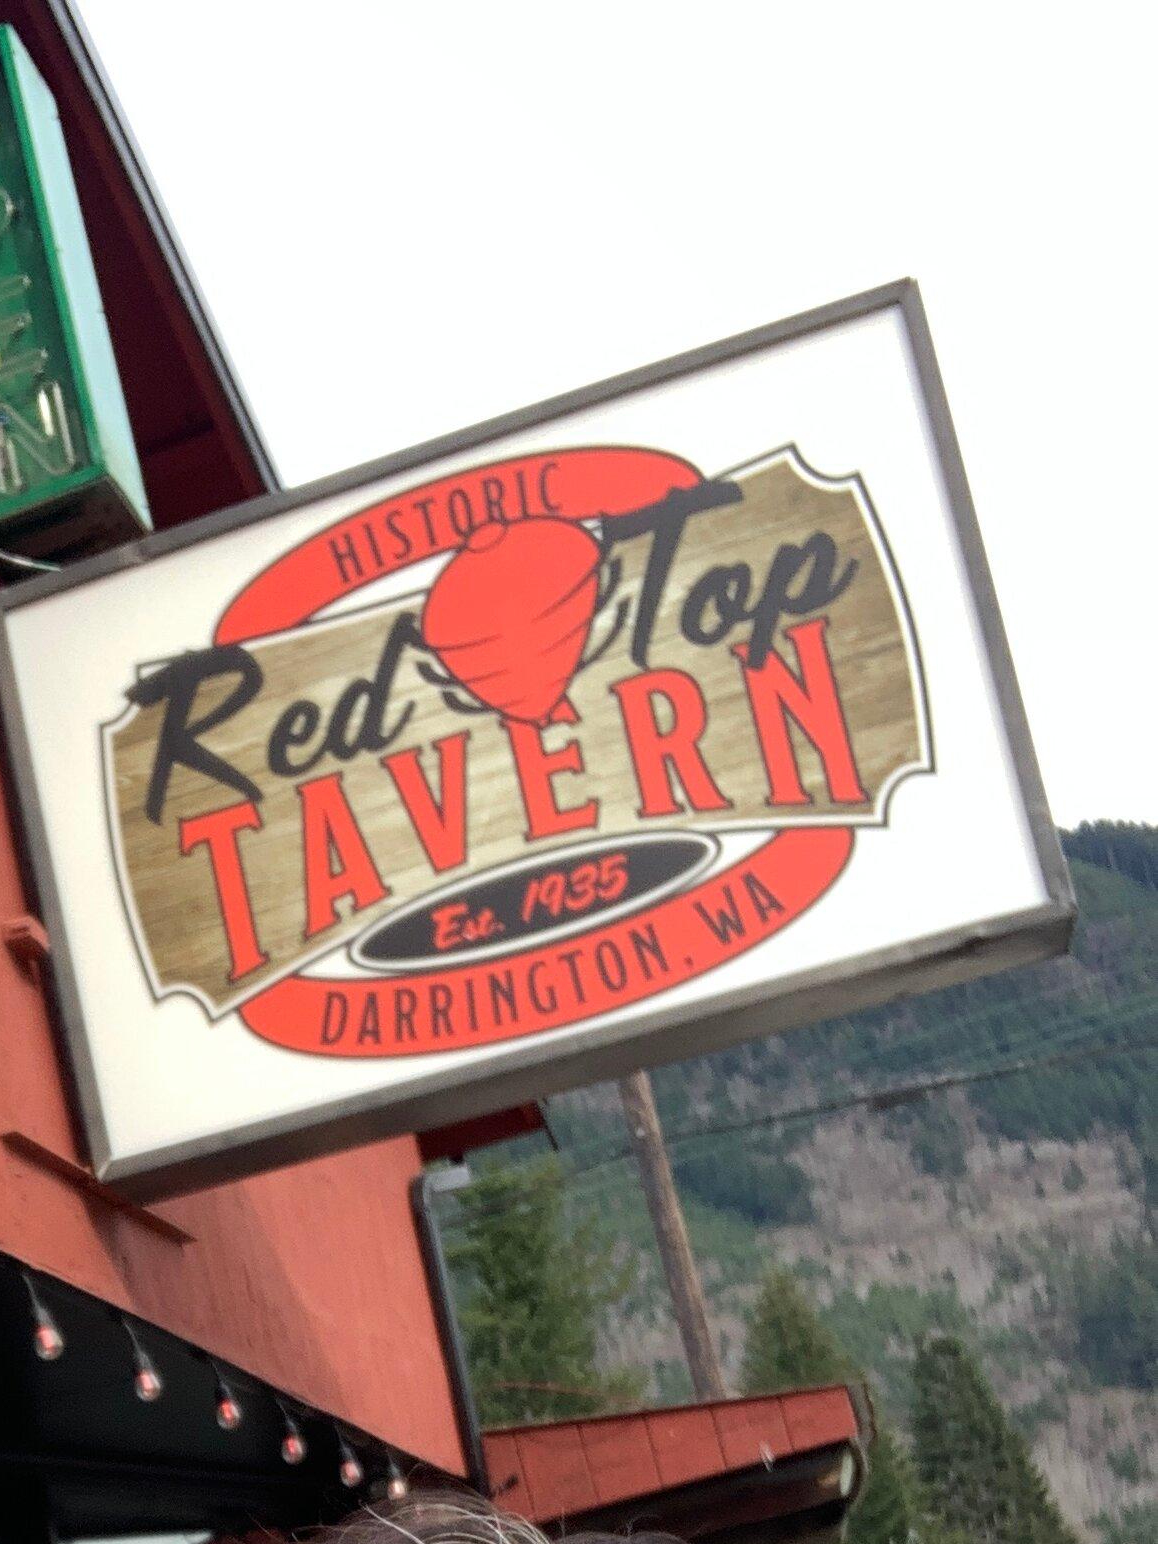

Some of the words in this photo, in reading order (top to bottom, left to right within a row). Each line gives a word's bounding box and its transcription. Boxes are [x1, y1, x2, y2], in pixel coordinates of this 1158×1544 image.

[330, 461, 564, 583] HISTORIC
[124, 612, 426, 825] Red
[600, 478, 860, 671] Top
[178, 615, 872, 986] TAVERN
[429, 902, 505, 951] Est.
[520, 853, 630, 925] 1935
[693, 871, 787, 946] WA
